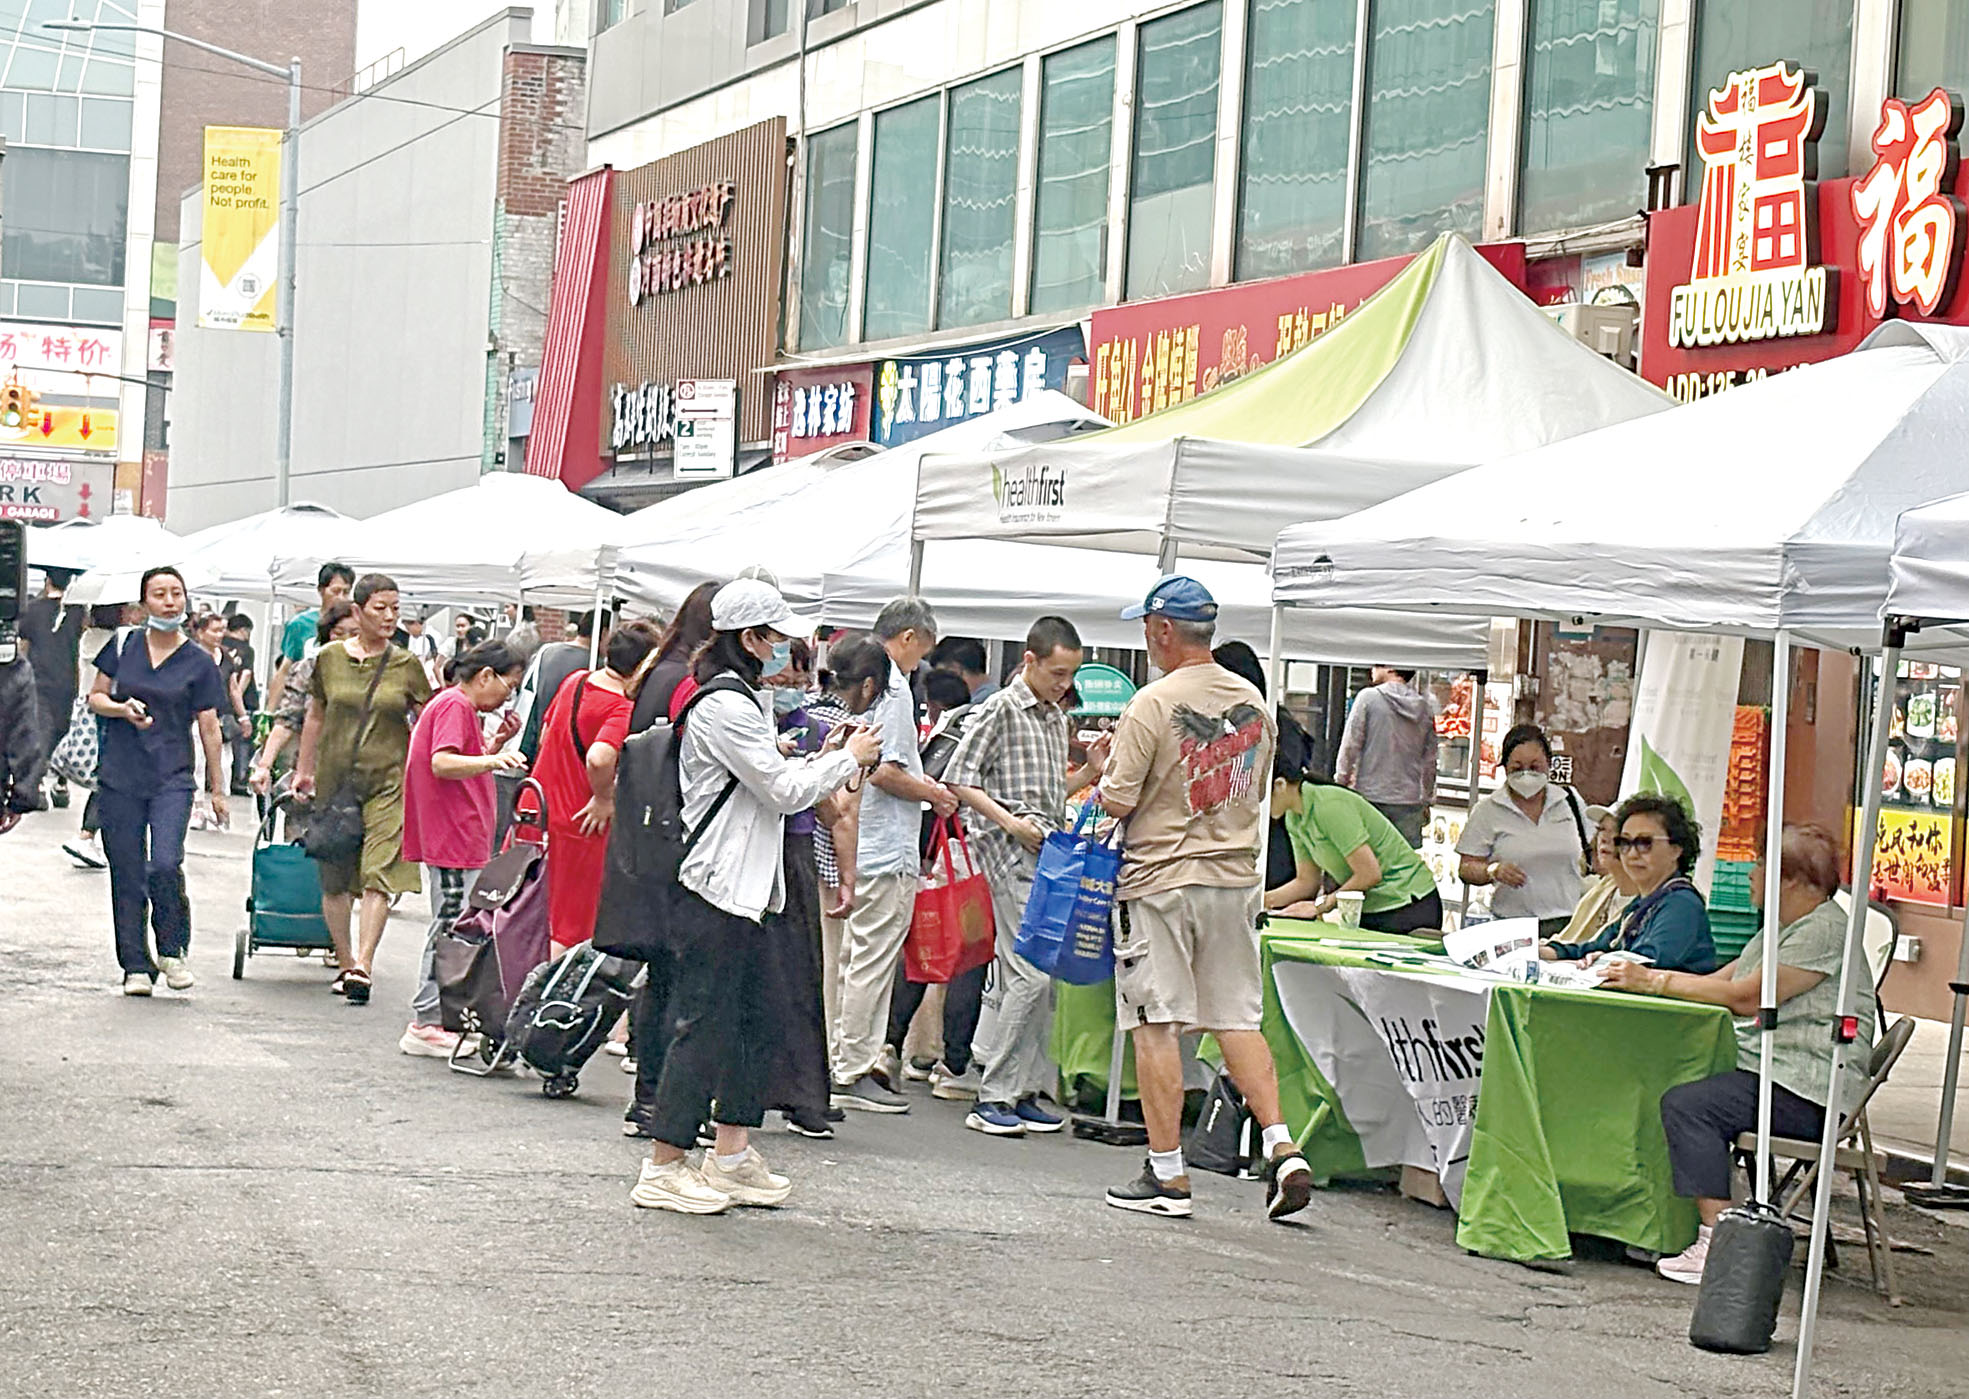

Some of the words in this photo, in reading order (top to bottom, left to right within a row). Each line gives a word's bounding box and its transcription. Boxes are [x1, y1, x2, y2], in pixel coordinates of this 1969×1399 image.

[211, 155, 251, 168] Health
[211, 170, 237, 181] care
[241, 170, 258, 182] for
[211, 196, 232, 207] Not
[1853, 88, 1954, 318] 福
[679, 421, 694, 437] 2
[1001, 464, 1065, 509] healthfirst
